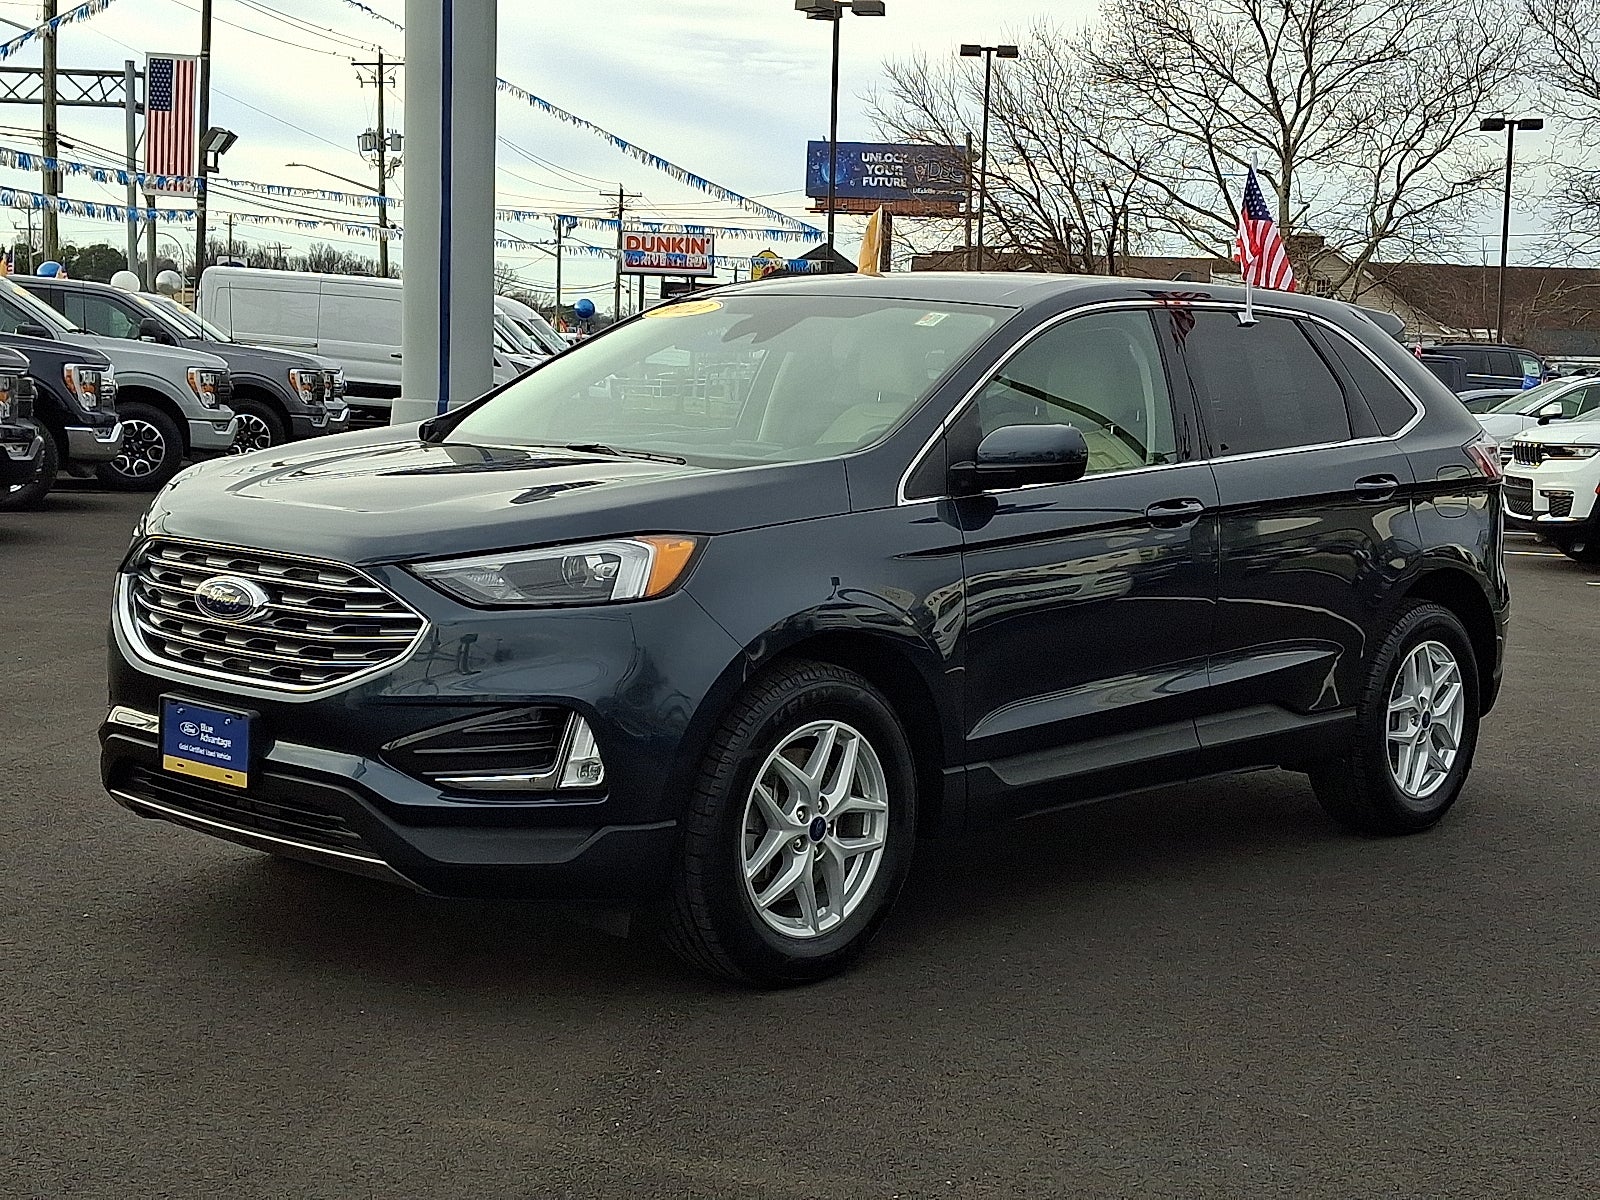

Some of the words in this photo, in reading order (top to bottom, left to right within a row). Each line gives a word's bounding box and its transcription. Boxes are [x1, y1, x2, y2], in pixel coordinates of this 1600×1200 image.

[865, 164, 903, 176] YOUR
[862, 176, 908, 188] FUTURE
[626, 235, 711, 254] DUNKIN'
[200, 722, 214, 734] Blue
[178, 742, 189, 751] Gold
[200, 732, 232, 749] Advantage
